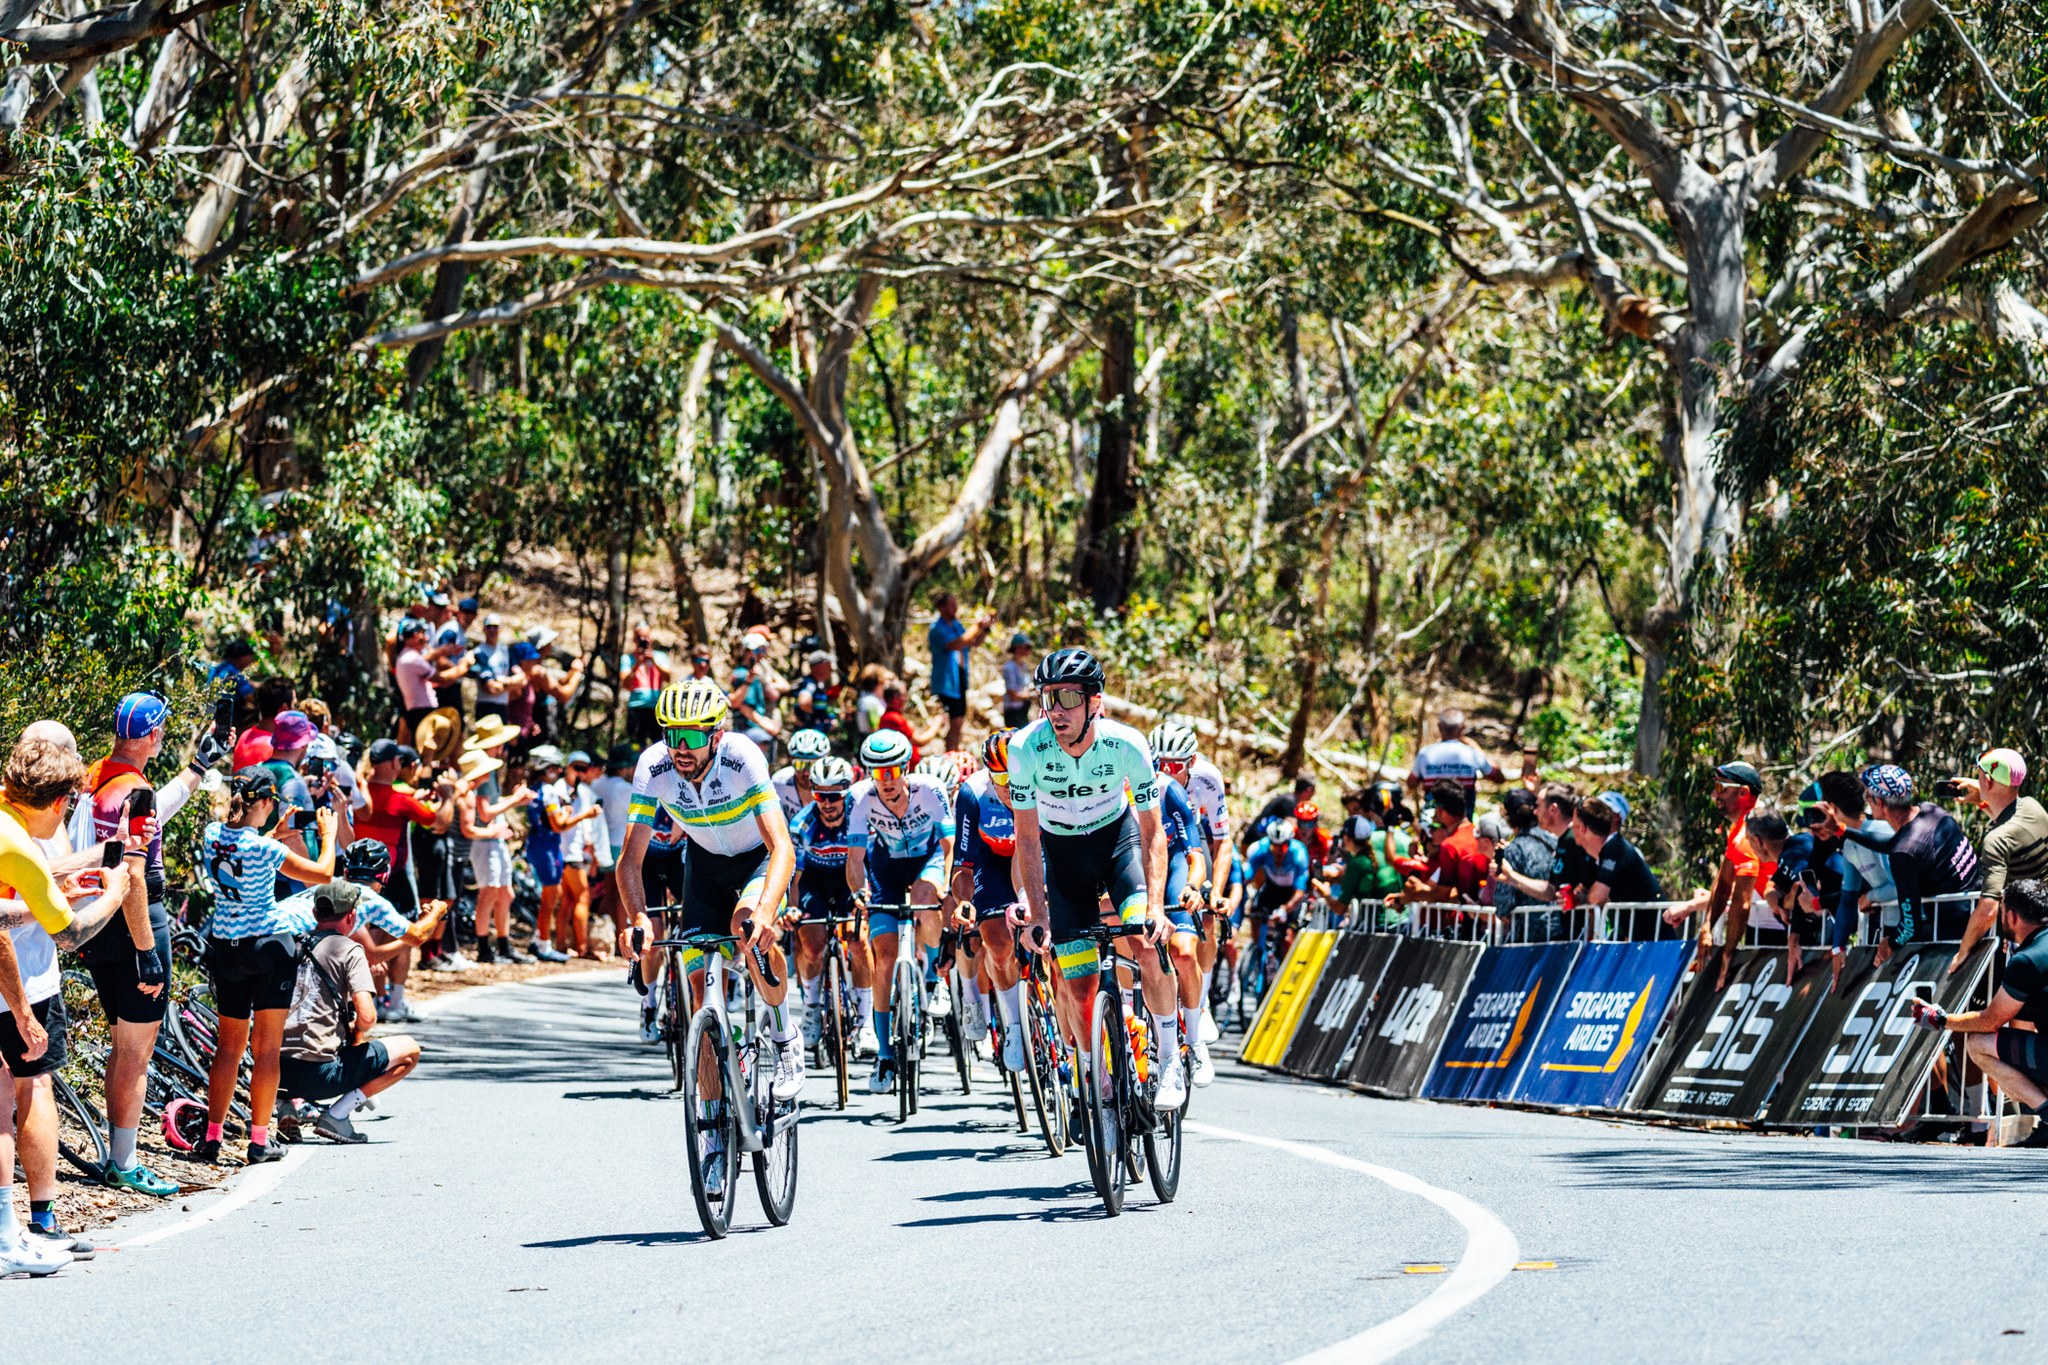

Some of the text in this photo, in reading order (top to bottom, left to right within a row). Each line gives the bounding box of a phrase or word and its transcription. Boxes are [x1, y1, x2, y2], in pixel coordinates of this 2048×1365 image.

[720, 757, 744, 773] Santini
[708, 794, 731, 806] Santini
[960, 814, 971, 851] GIANT
[682, 926, 701, 938] Santini
[1378, 983, 1444, 1045] LAZER
[1468, 991, 1526, 1019] SINGAPORE
[1565, 991, 1635, 1019] SINGAPORE
[1464, 1022, 1511, 1049] AIRLINES
[1563, 1024, 1620, 1052] AIRLINES
[1663, 1088, 1735, 1106] SCIENCE IN SPORT
[1801, 1096, 1874, 1112] SCIENCE IN SPORT
